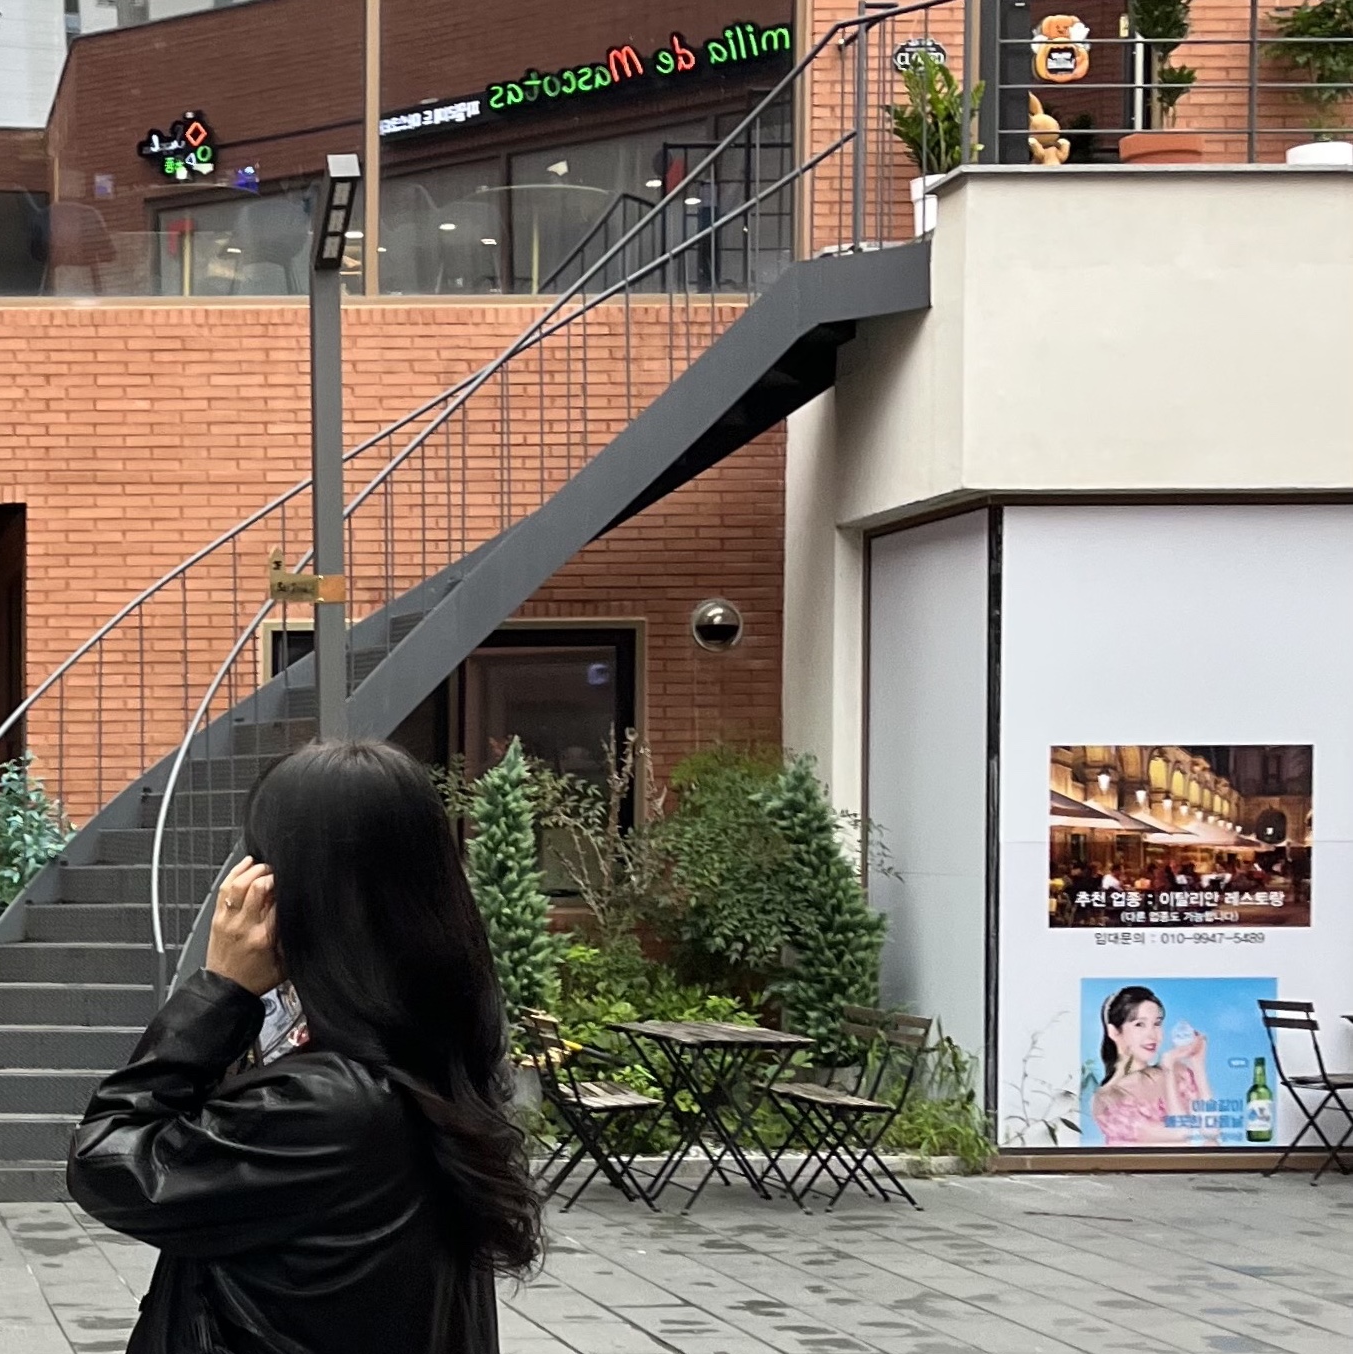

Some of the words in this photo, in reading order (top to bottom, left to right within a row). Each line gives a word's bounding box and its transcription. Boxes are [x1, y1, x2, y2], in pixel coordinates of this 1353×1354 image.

[1075, 891, 1106, 907] 추천
[1110, 891, 1142, 907] 업종
[1159, 891, 1220, 907] 이탈리안
[1225, 891, 1285, 907] 레스토랑
[1094, 932, 1145, 945] 임대문의
